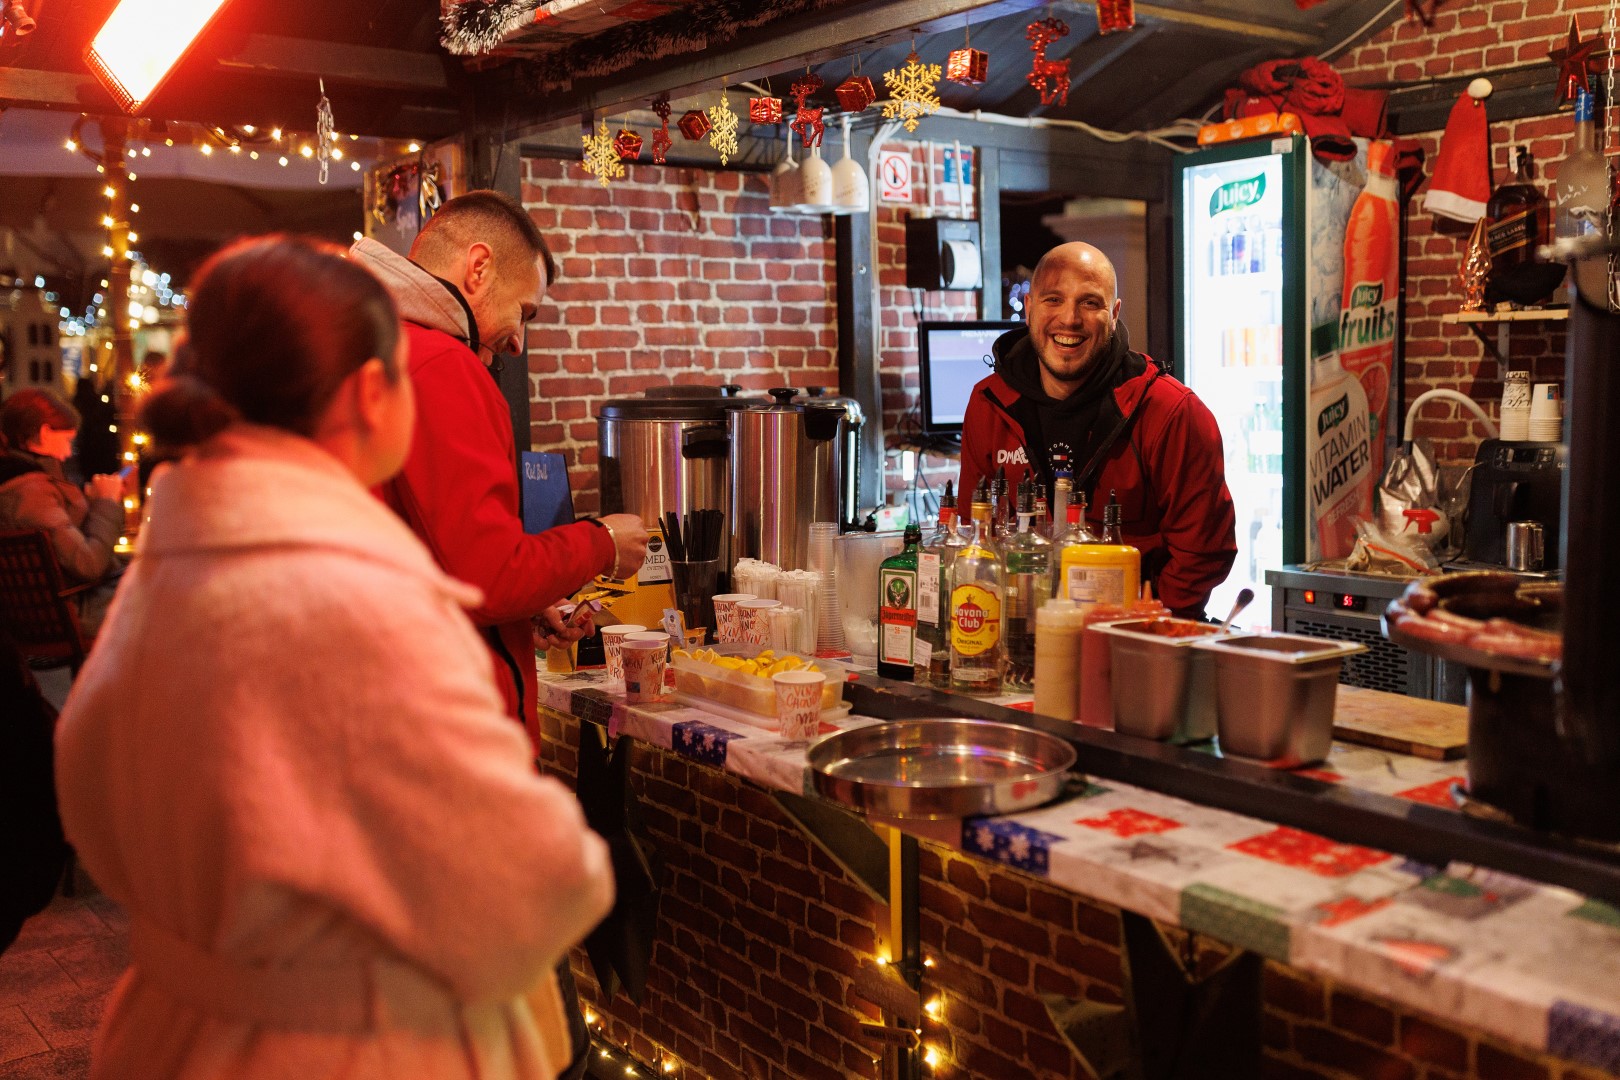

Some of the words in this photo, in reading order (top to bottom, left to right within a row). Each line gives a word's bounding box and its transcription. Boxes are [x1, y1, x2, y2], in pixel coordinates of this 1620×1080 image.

[1215, 179, 1260, 213] Juicy
[1341, 306, 1394, 349] fruits
[1048, 442, 1073, 453] TOMMY
[1310, 409, 1366, 478] VITAMIN
[1313, 439, 1369, 507] WATER
[645, 554, 666, 564] MED
[955, 605, 988, 618] Havana
[959, 617, 980, 629] Club
